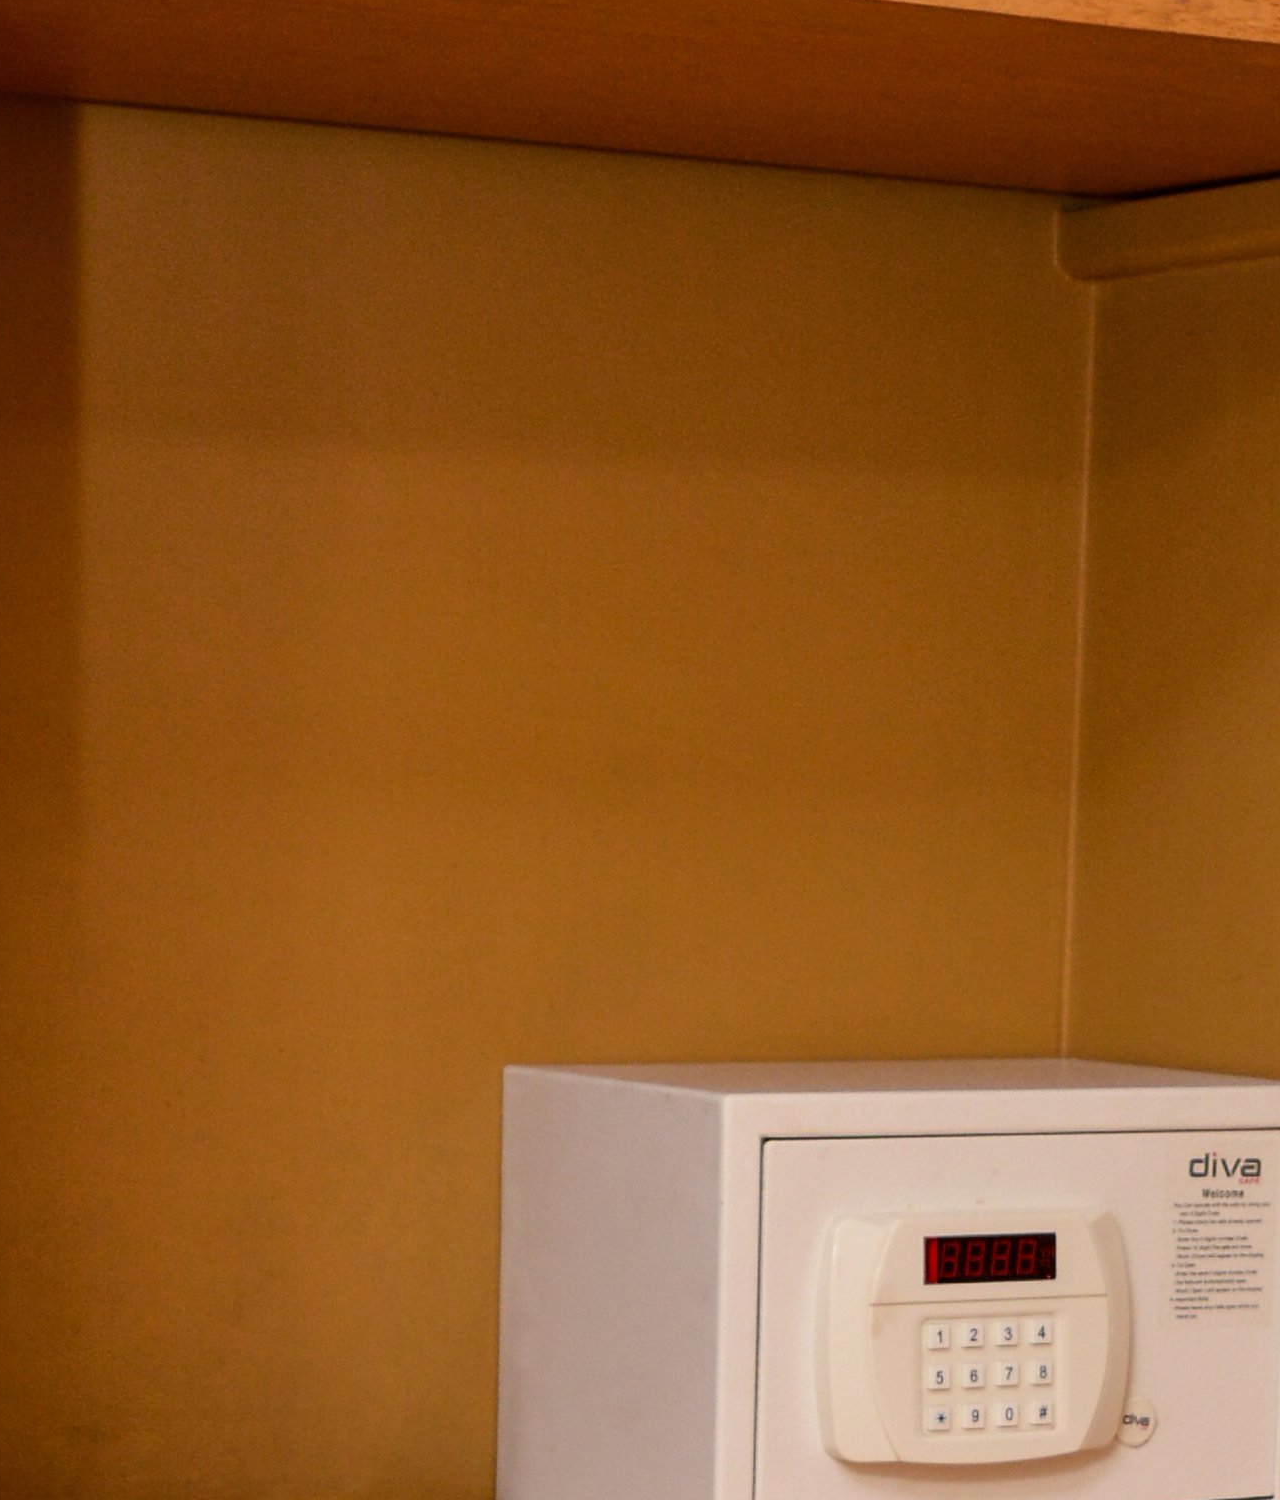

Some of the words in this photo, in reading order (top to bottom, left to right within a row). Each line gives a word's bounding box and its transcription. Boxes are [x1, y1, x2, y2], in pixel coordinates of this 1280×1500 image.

[1189, 1152, 1262, 1178] diva
[1202, 1188, 1244, 1198] Welcome
[937, 1330, 943, 1343] 1
[970, 1328, 978, 1341] 2
[1004, 1327, 1013, 1340] 3
[1038, 1325, 1046, 1338] 4
[936, 1370, 944, 1384] 5
[970, 1369, 978, 1382] 6
[1005, 1366, 1013, 1380] 7
[1039, 1365, 1047, 1379] 8
[971, 1409, 979, 1422] 9
[1005, 1407, 1013, 1421] 0
